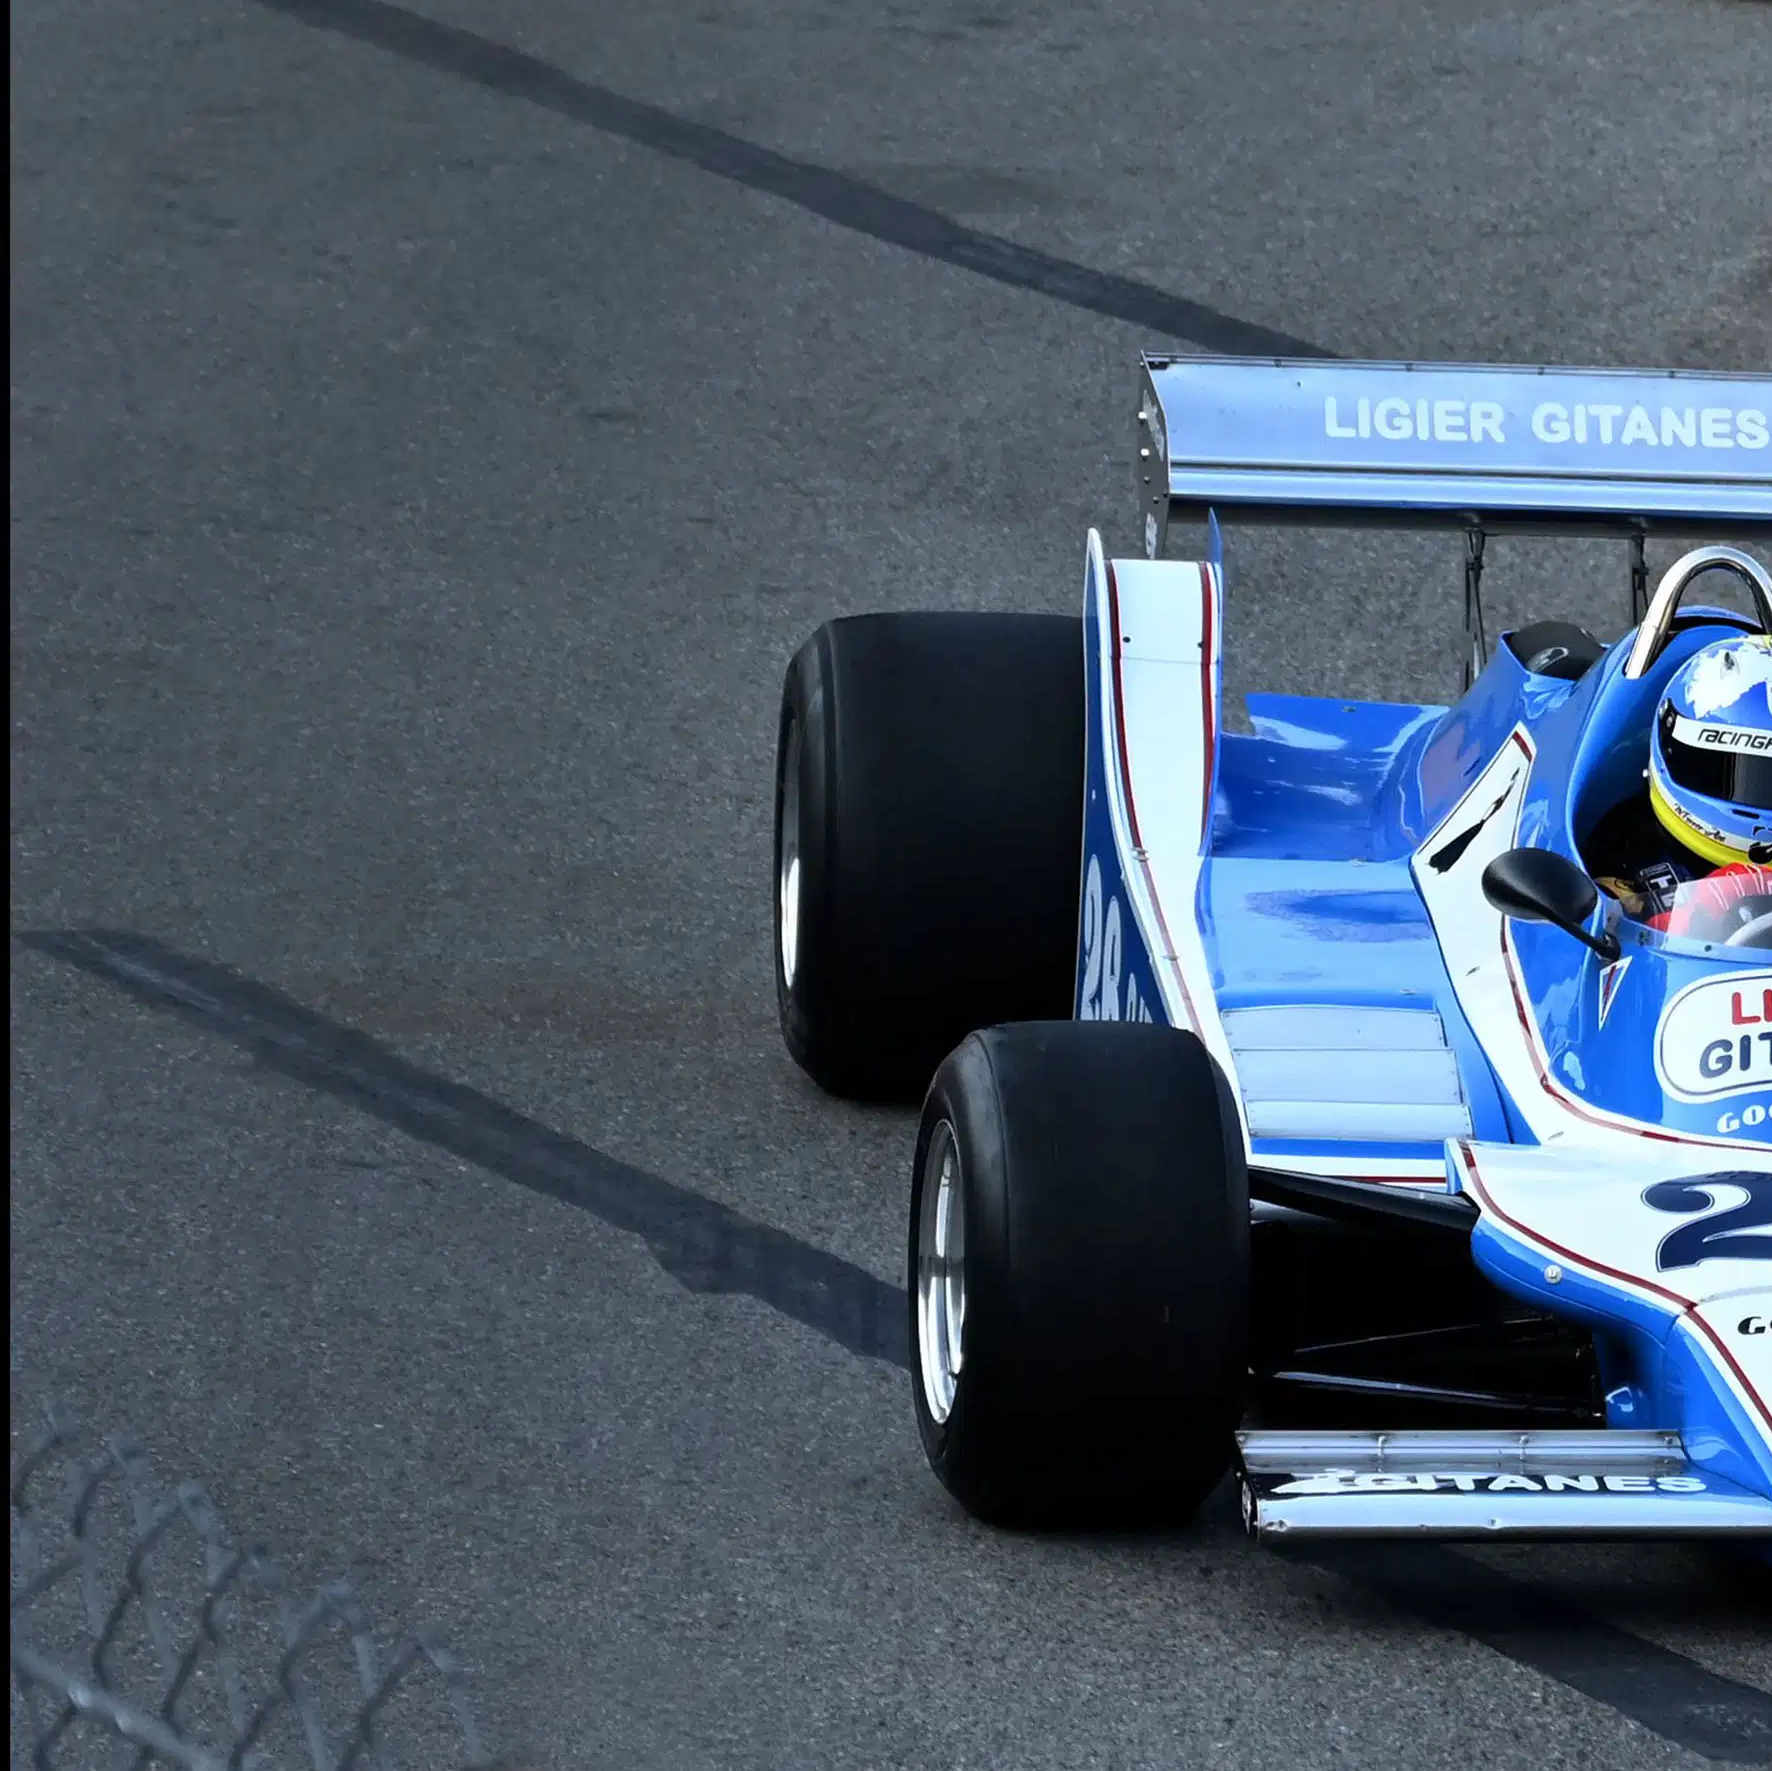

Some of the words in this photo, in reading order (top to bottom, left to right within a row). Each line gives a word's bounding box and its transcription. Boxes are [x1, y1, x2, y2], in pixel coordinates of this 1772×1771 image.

[1323, 396, 1505, 444] LIGIER
[1532, 400, 1770, 451] GITANES
[1352, 1473, 1707, 1493] GITANES
